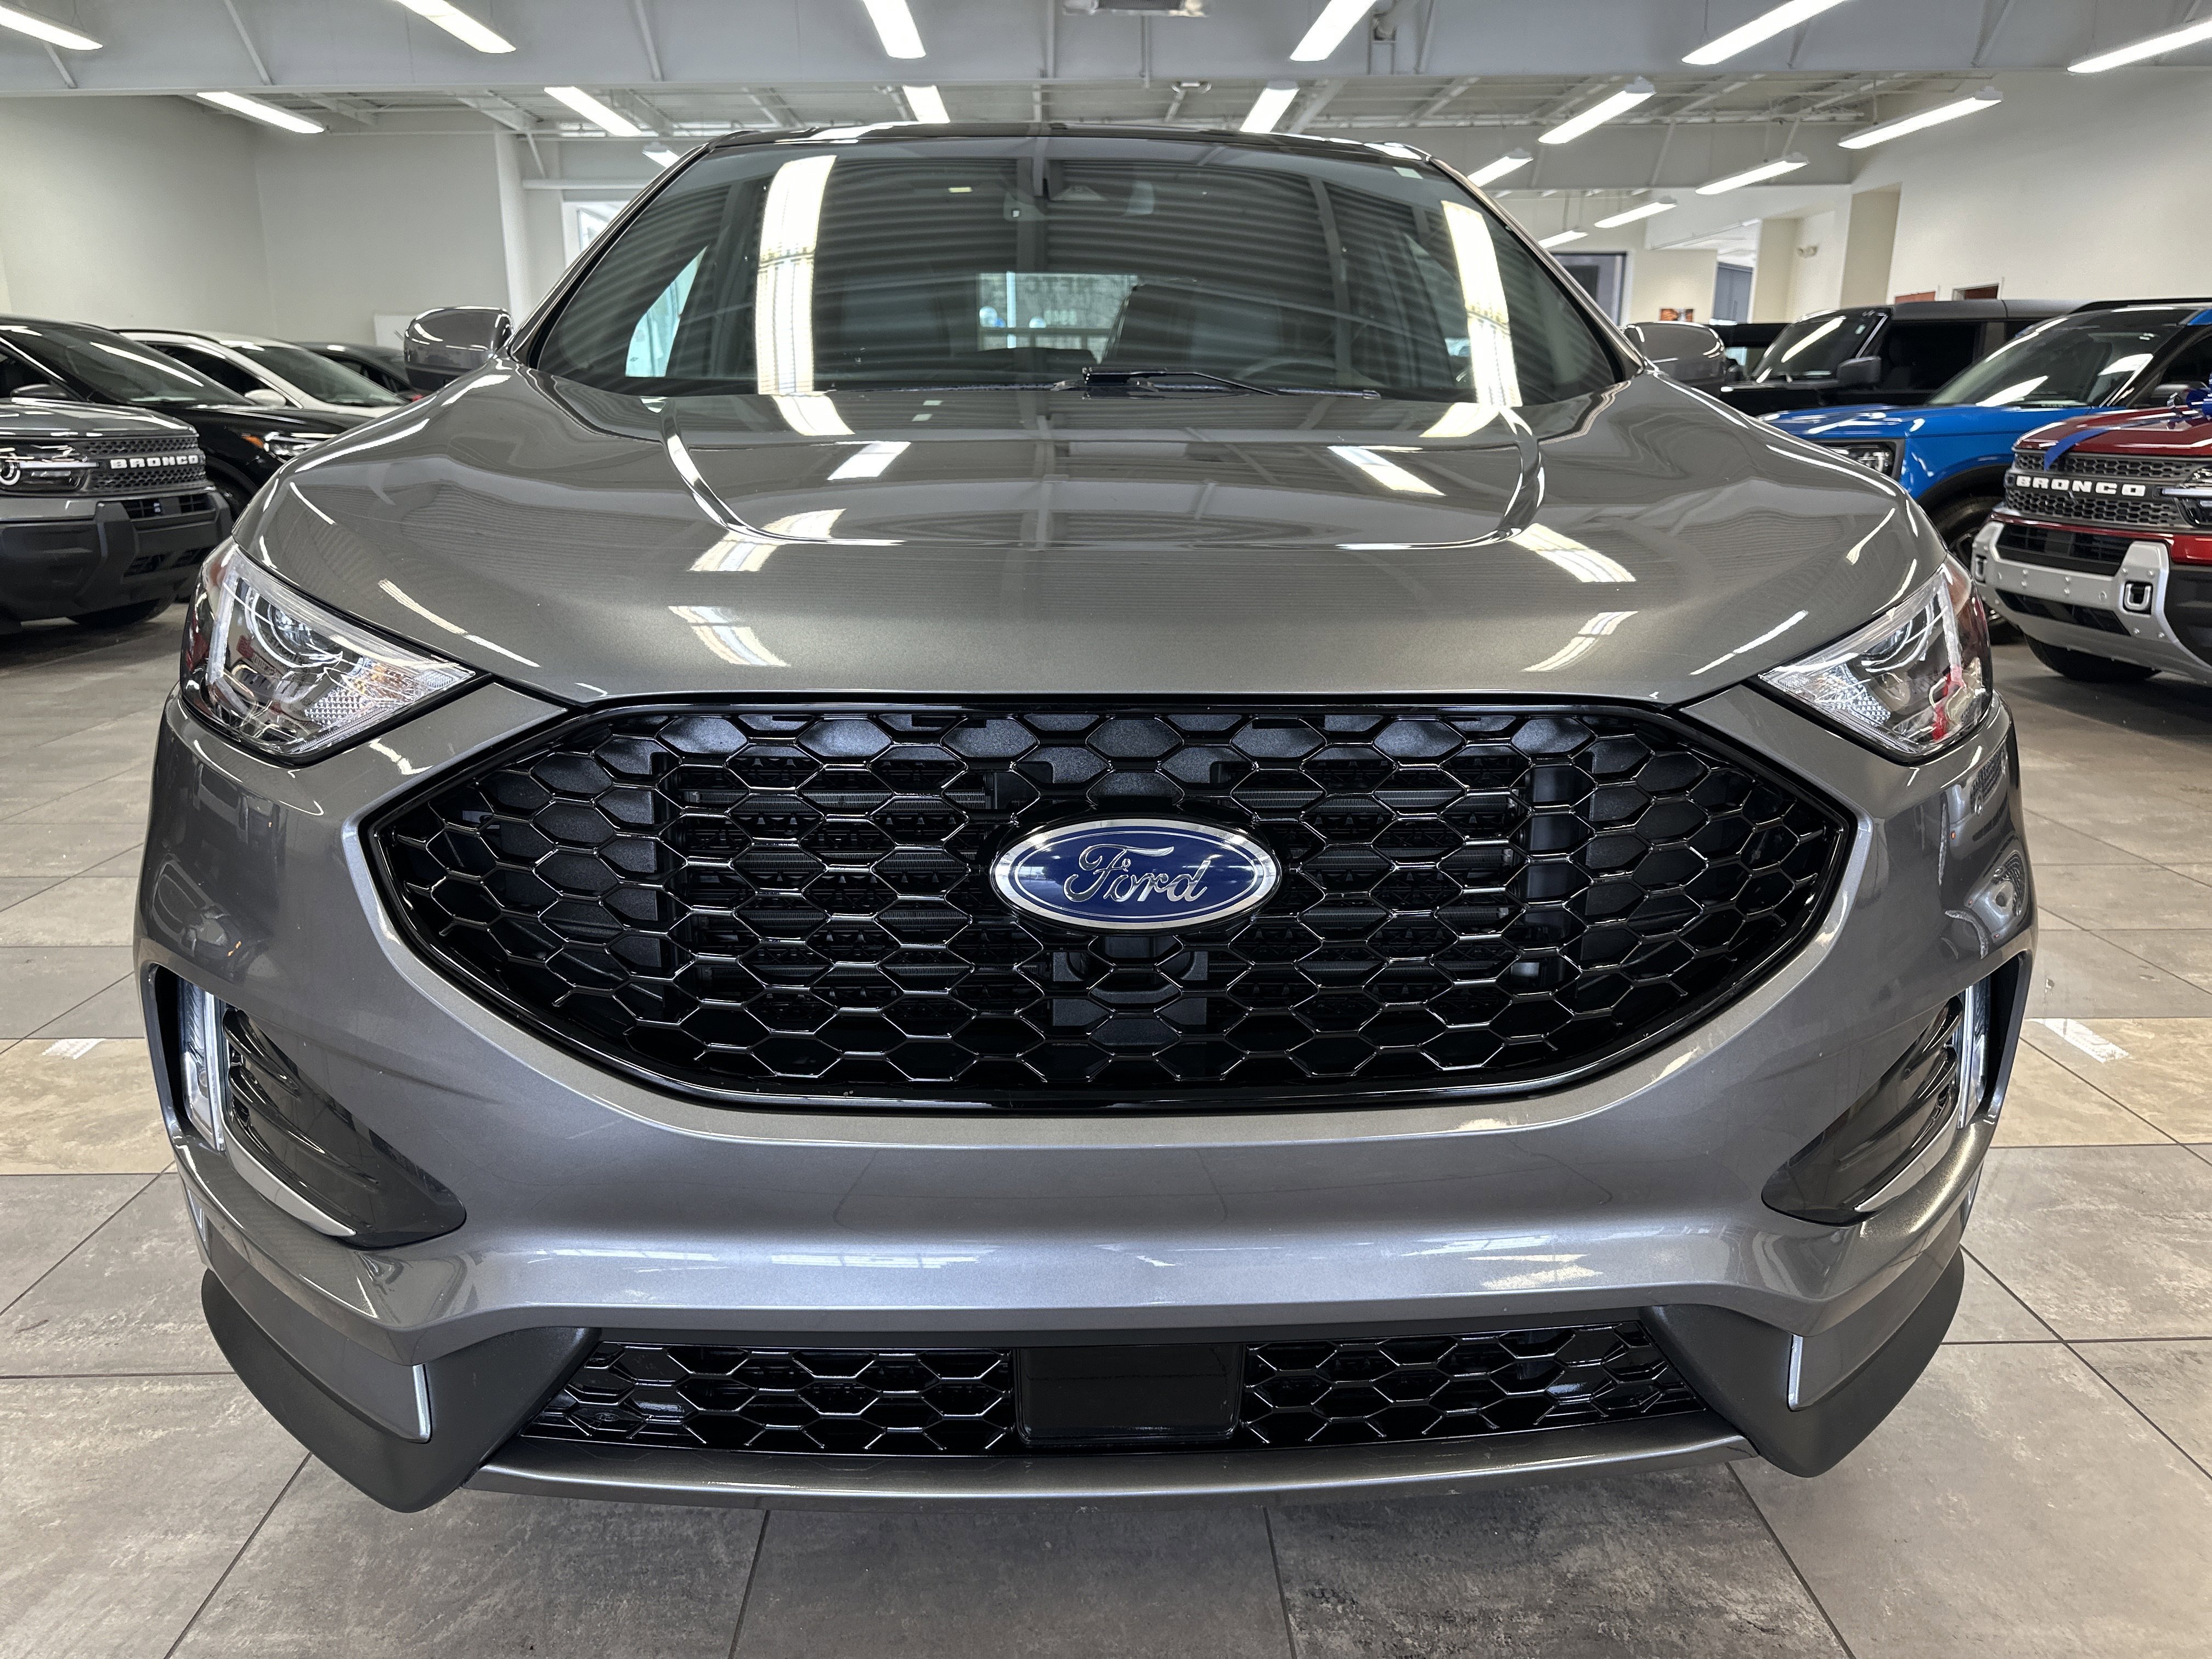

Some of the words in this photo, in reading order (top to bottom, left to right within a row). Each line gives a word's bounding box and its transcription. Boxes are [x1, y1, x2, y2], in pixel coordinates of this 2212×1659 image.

[110, 455, 199, 469] BRONCO
[2016, 475, 2146, 497] BRONCO
[1063, 843, 1211, 902] Ford
